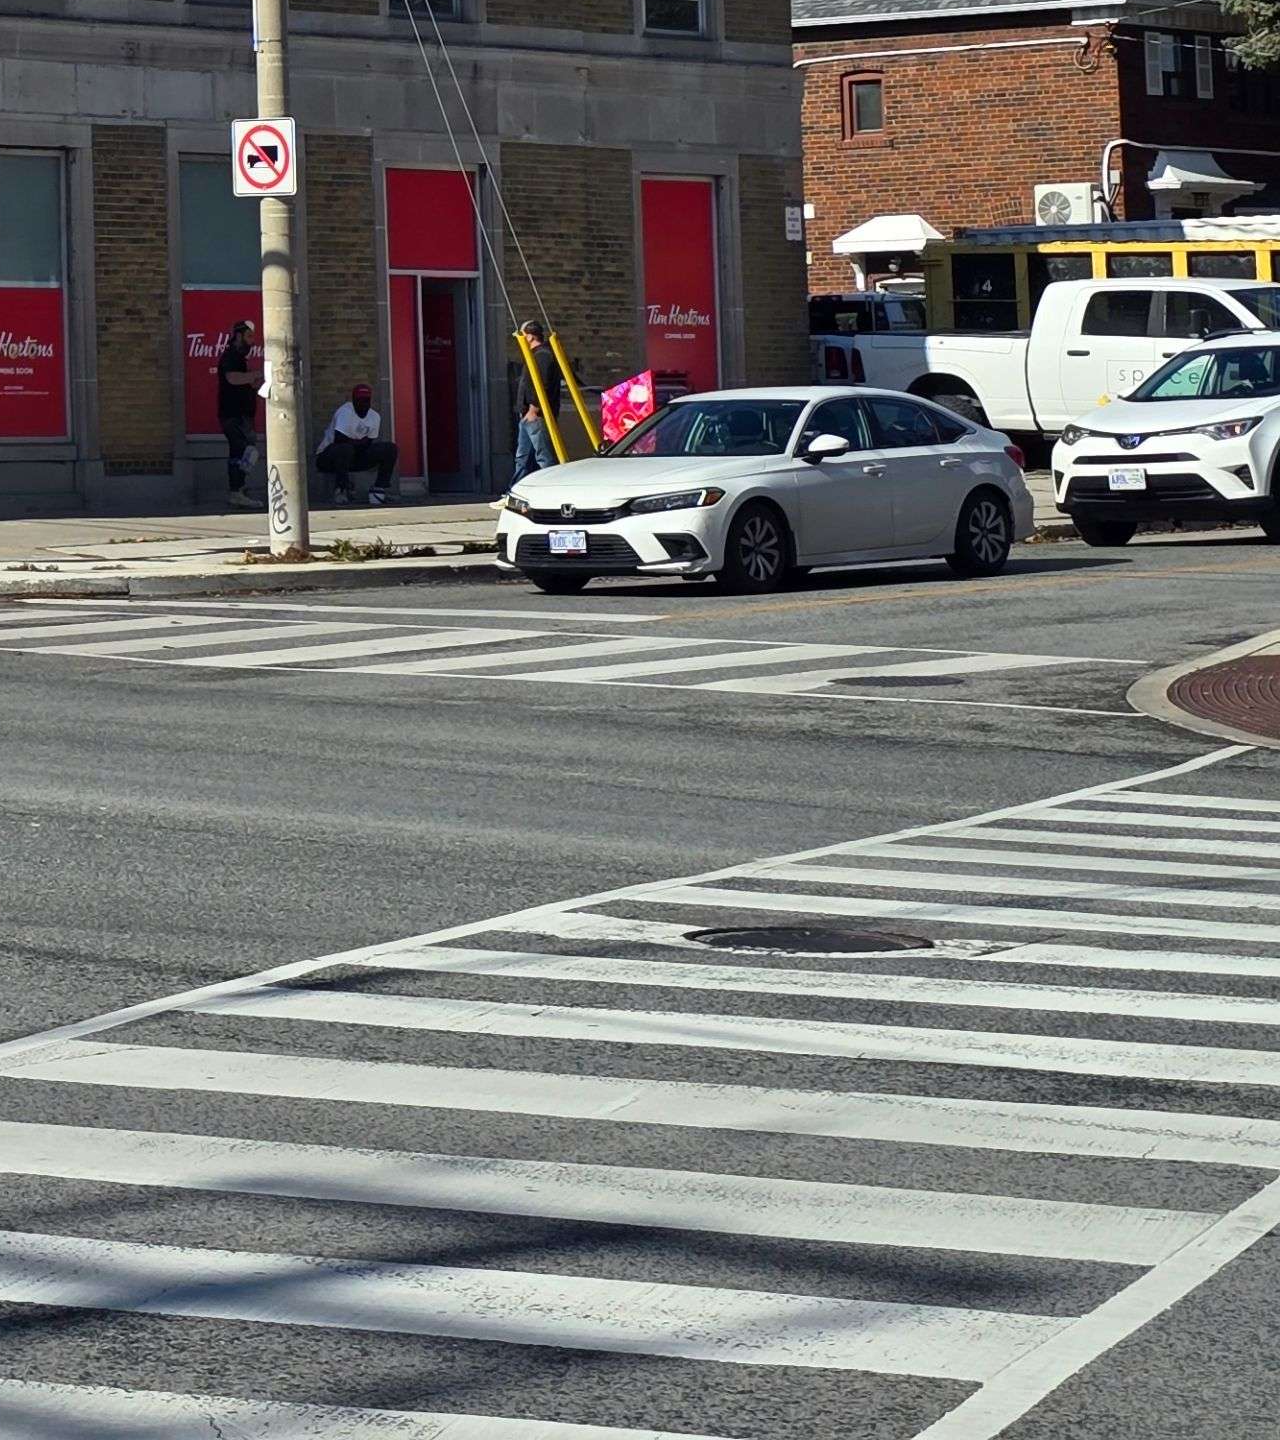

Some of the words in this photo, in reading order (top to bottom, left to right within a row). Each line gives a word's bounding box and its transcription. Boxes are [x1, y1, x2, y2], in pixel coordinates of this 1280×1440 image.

[646, 304, 668, 326] Tim
[668, 303, 711, 327] Hortons
[186, 333, 214, 358] Tim
[16, 367, 34, 375] SOON
[1118, 368, 1201, 385] spce
